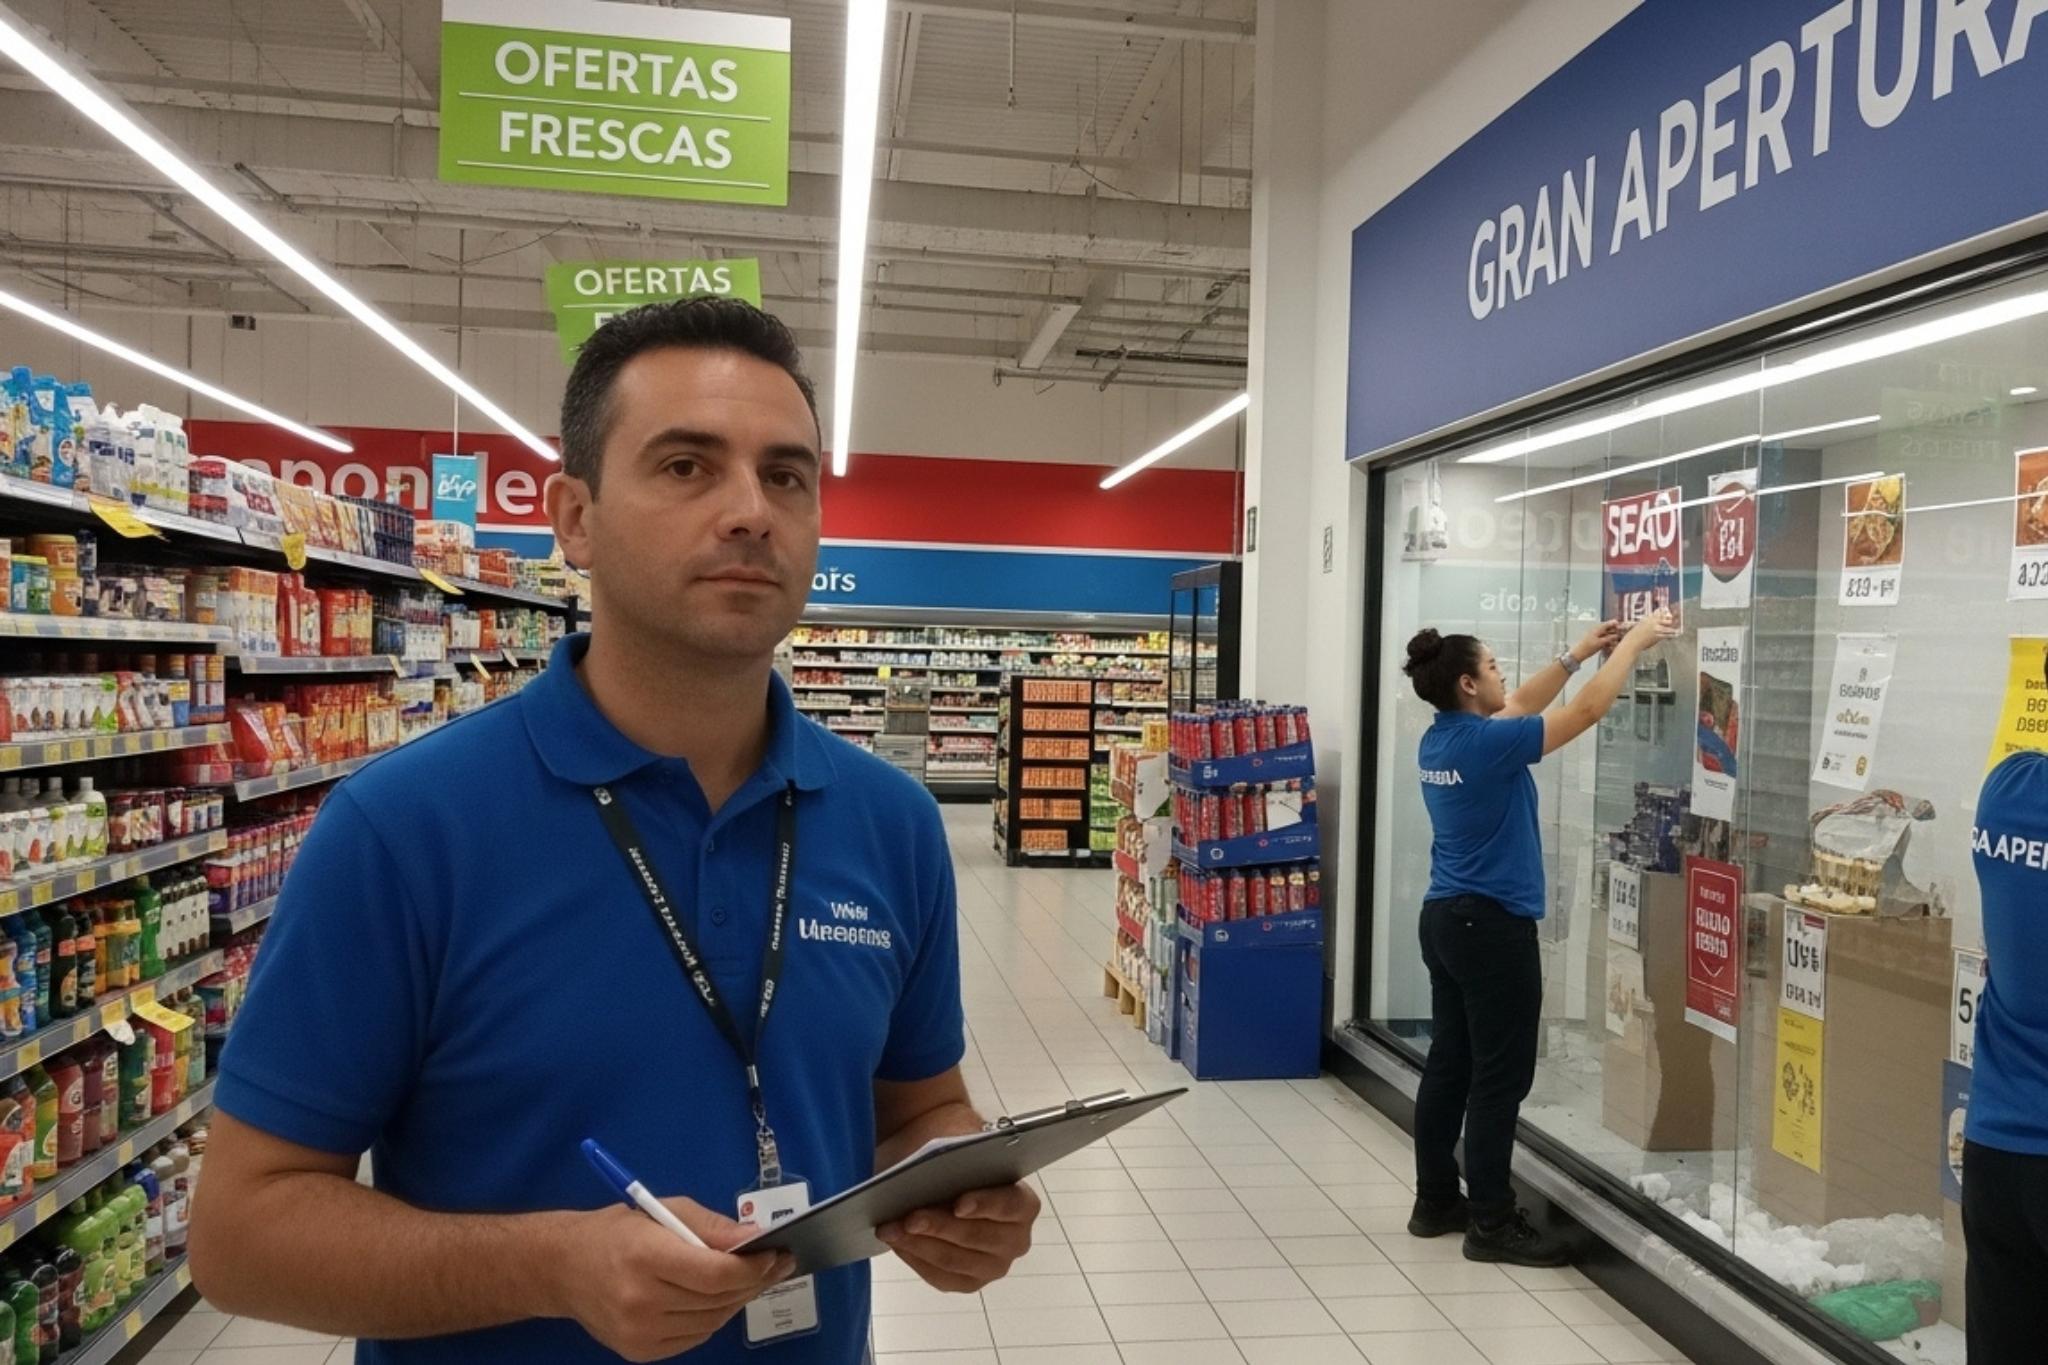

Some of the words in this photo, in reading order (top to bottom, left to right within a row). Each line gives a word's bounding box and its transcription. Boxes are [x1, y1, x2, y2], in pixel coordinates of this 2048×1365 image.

[494, 40, 739, 103] OFERTAS
[499, 110, 733, 170] FRESCAS
[1467, 155, 1596, 321] GRAN
[1609, 0, 2048, 256] APERTUR
[574, 267, 732, 296] OFERTAS
